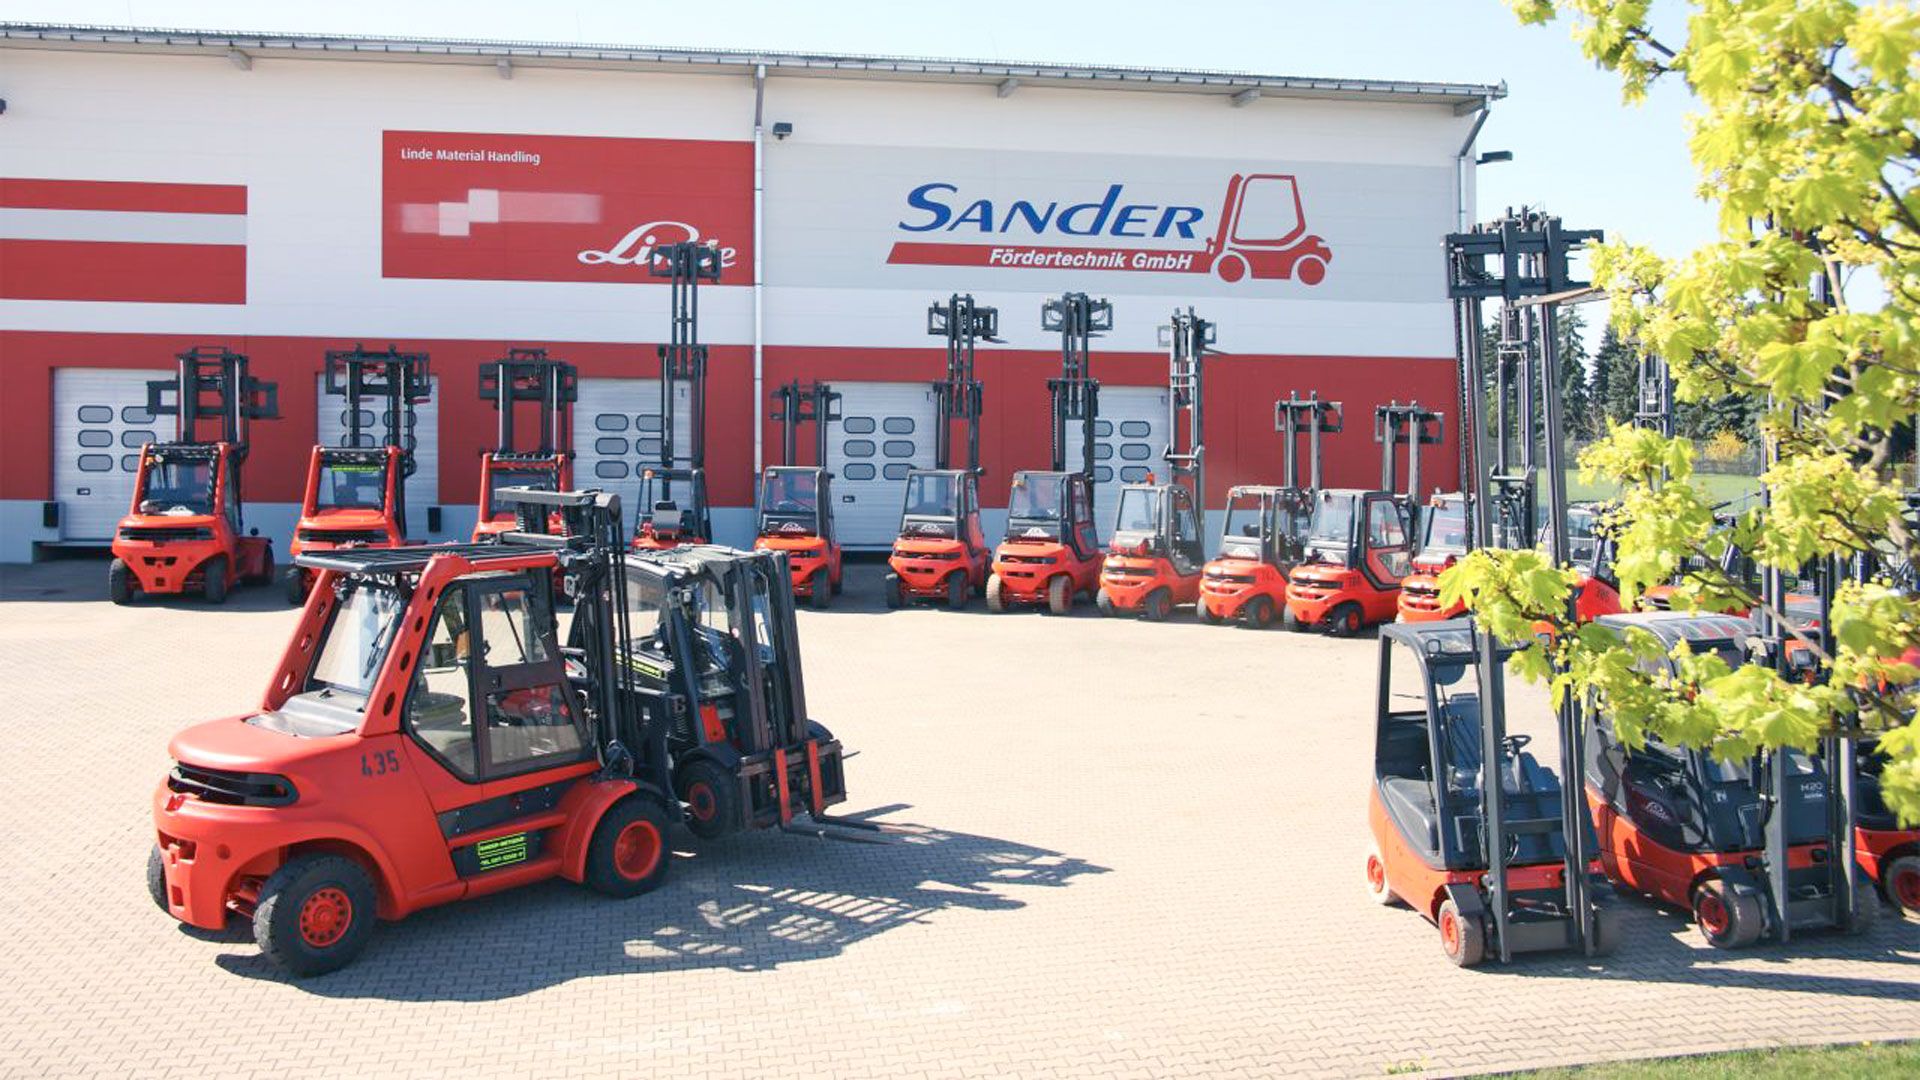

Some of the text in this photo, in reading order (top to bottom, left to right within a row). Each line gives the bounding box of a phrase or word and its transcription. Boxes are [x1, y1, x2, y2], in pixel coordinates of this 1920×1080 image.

[401, 148, 541, 166] Linde Material Handling
[989, 248, 1194, 270] Fördertechnik GmbH
[361, 750, 399, 777] 435
